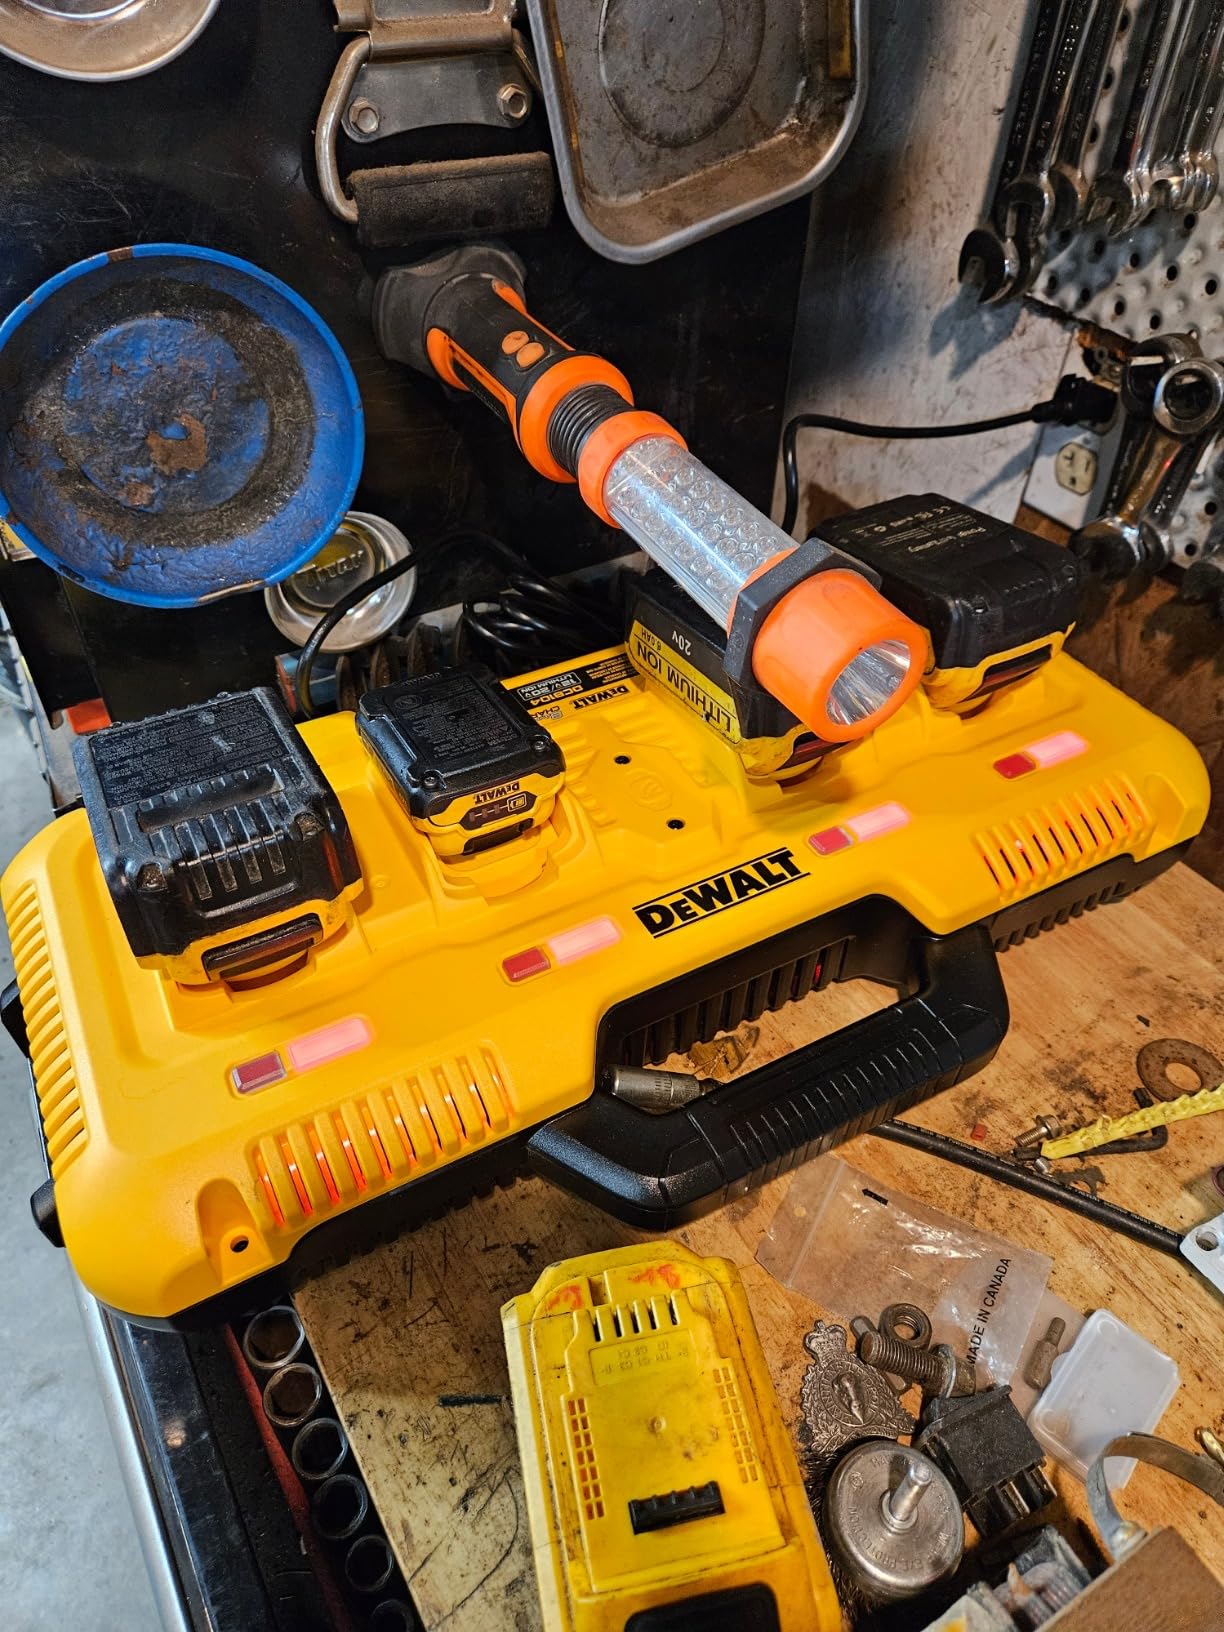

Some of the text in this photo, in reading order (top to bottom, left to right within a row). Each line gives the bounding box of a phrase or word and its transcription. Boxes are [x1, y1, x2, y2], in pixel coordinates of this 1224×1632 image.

[637, 640, 662, 674] ION
[521, 673, 573, 694] LITHIUM ION
[530, 685, 584, 706] DCB104
[667, 666, 731, 732] LITHIUM
[966, 1258, 1012, 1367] MADE IN CANADA
